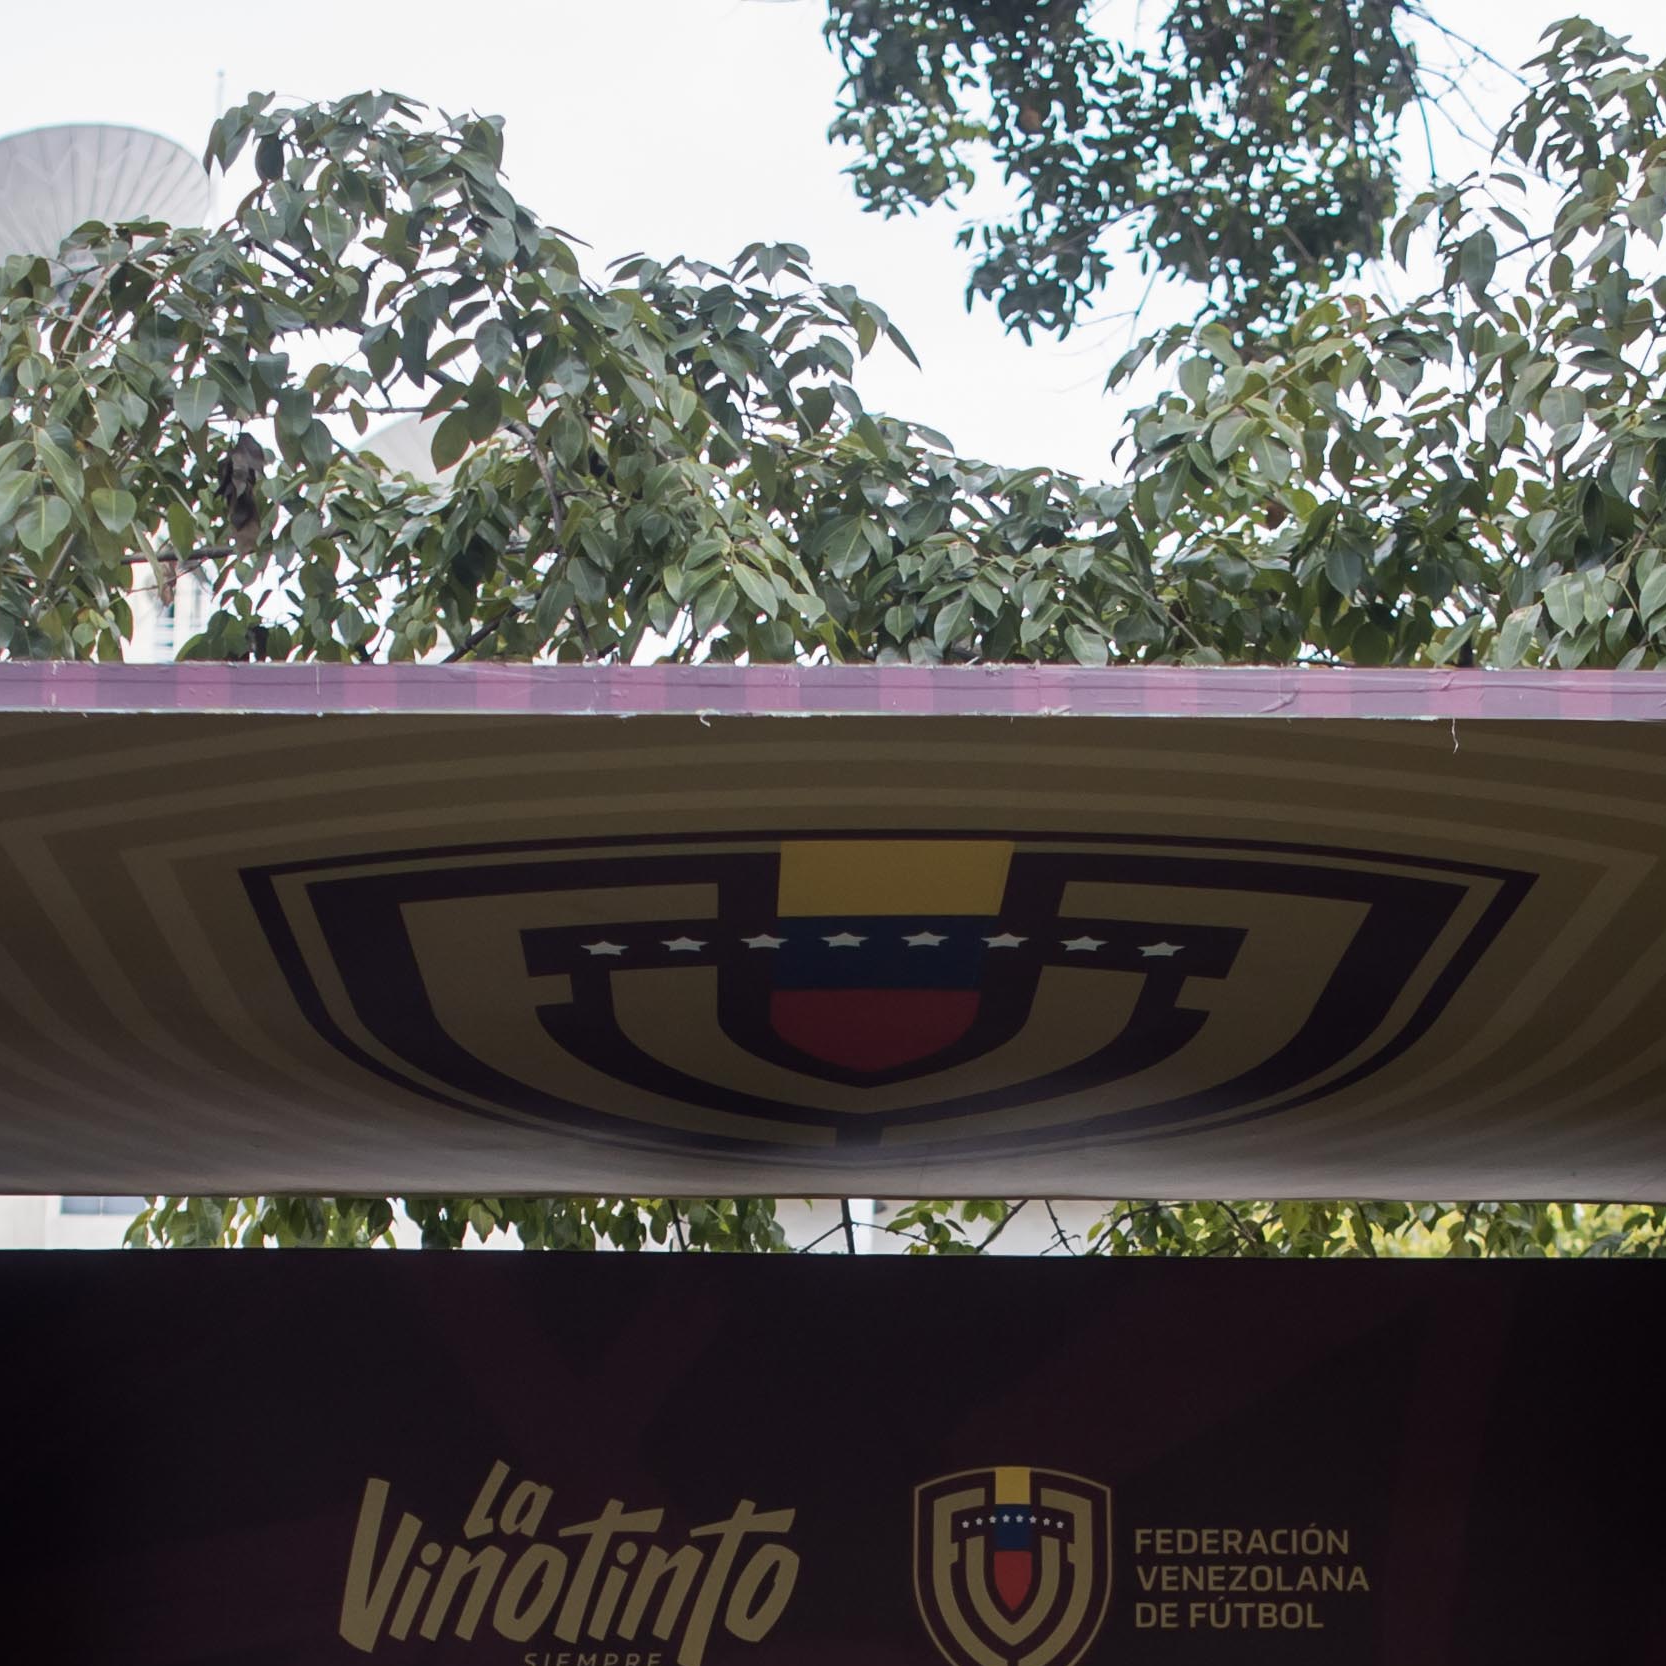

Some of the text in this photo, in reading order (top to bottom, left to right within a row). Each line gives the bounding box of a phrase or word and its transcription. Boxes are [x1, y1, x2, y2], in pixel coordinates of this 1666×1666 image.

[462, 1460, 554, 1541] La
[1134, 1523, 1349, 1555] FEDERACIÓN
[1136, 1565, 1370, 1592] VENEZOLANA
[1135, 1596, 1325, 1629] DE FÚTBOL
